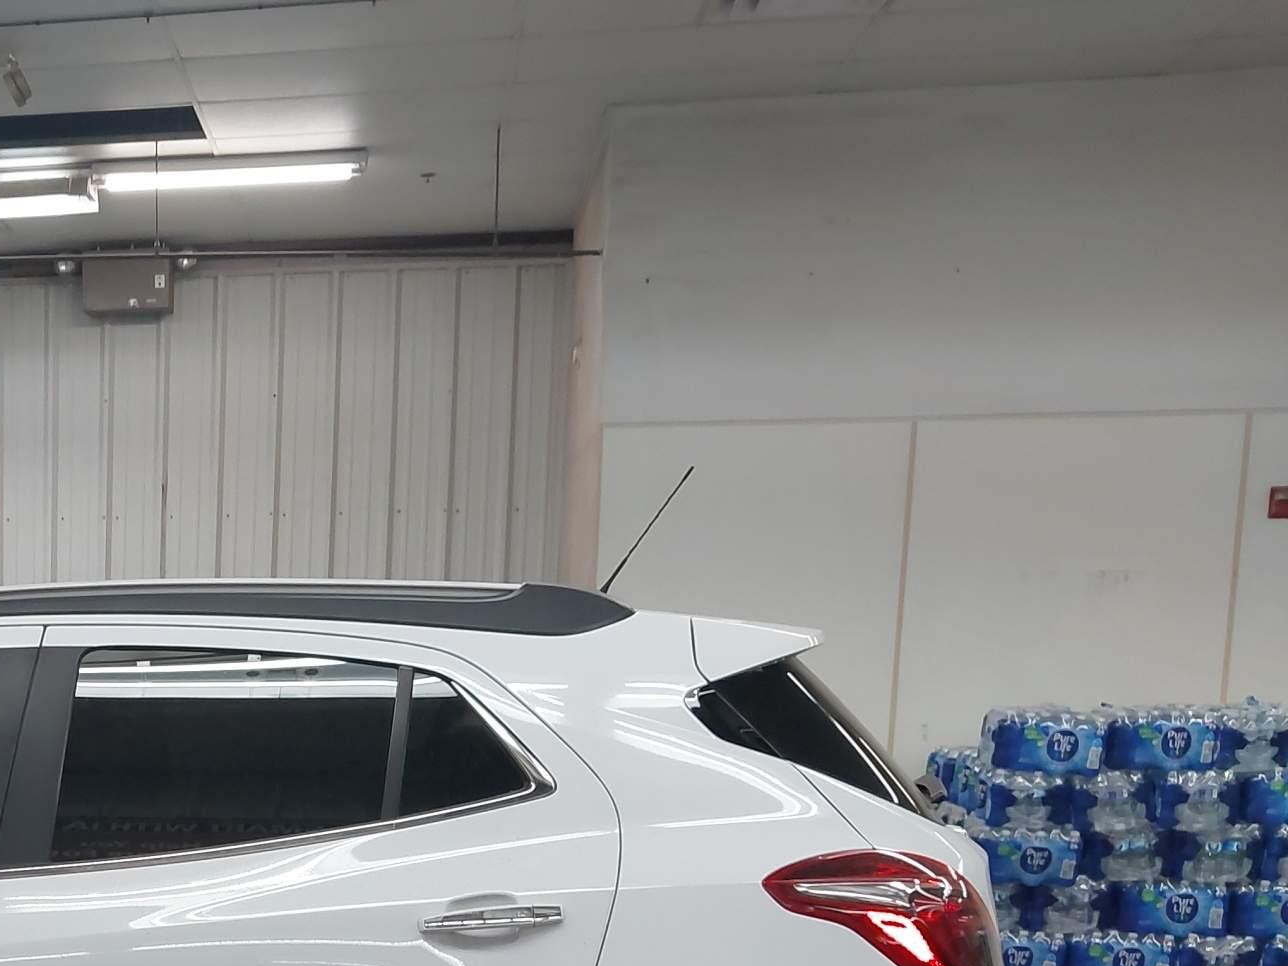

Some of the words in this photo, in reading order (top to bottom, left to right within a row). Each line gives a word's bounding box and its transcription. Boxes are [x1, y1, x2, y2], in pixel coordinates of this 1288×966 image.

[1053, 732, 1076, 744] Pure
[1167, 730, 1189, 741] Pure
[1054, 740, 1074, 757] Life
[1168, 738, 1187, 755] Life
[1026, 847, 1049, 858] Pure
[1027, 856, 1047, 871] Life
[1172, 895, 1195, 906] Pure
[1173, 903, 1193, 920] Life
[1118, 951, 1141, 962] Pure
